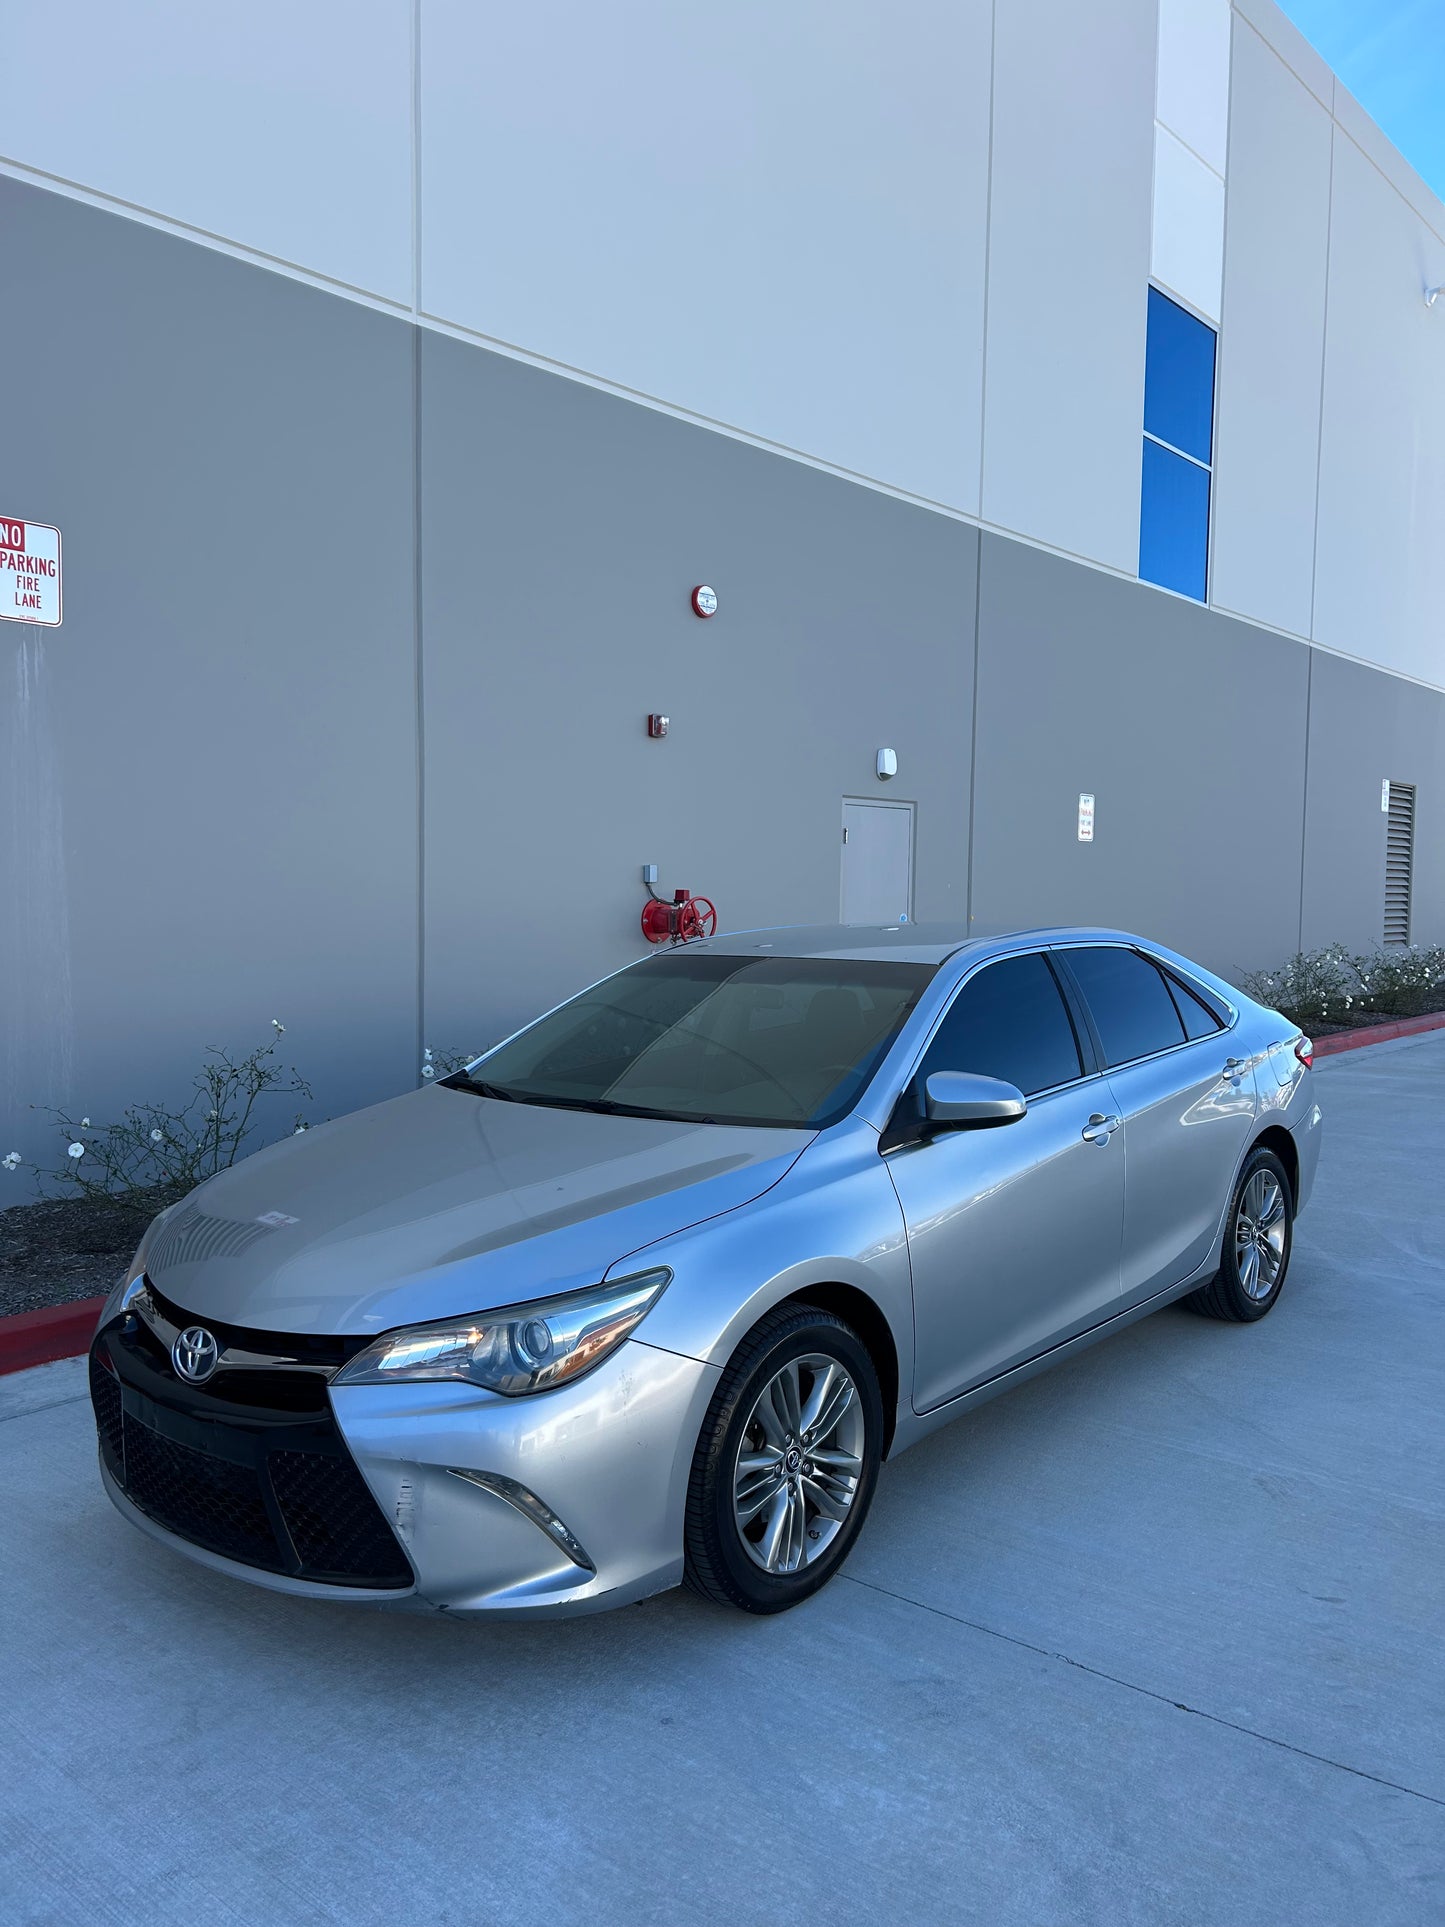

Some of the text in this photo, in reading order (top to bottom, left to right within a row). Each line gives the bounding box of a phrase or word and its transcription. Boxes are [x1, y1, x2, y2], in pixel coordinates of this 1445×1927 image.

[0, 523, 21, 547] NO
[0, 551, 56, 577] PARKING
[17, 575, 40, 592] FIRE
[15, 592, 42, 609] LANE
